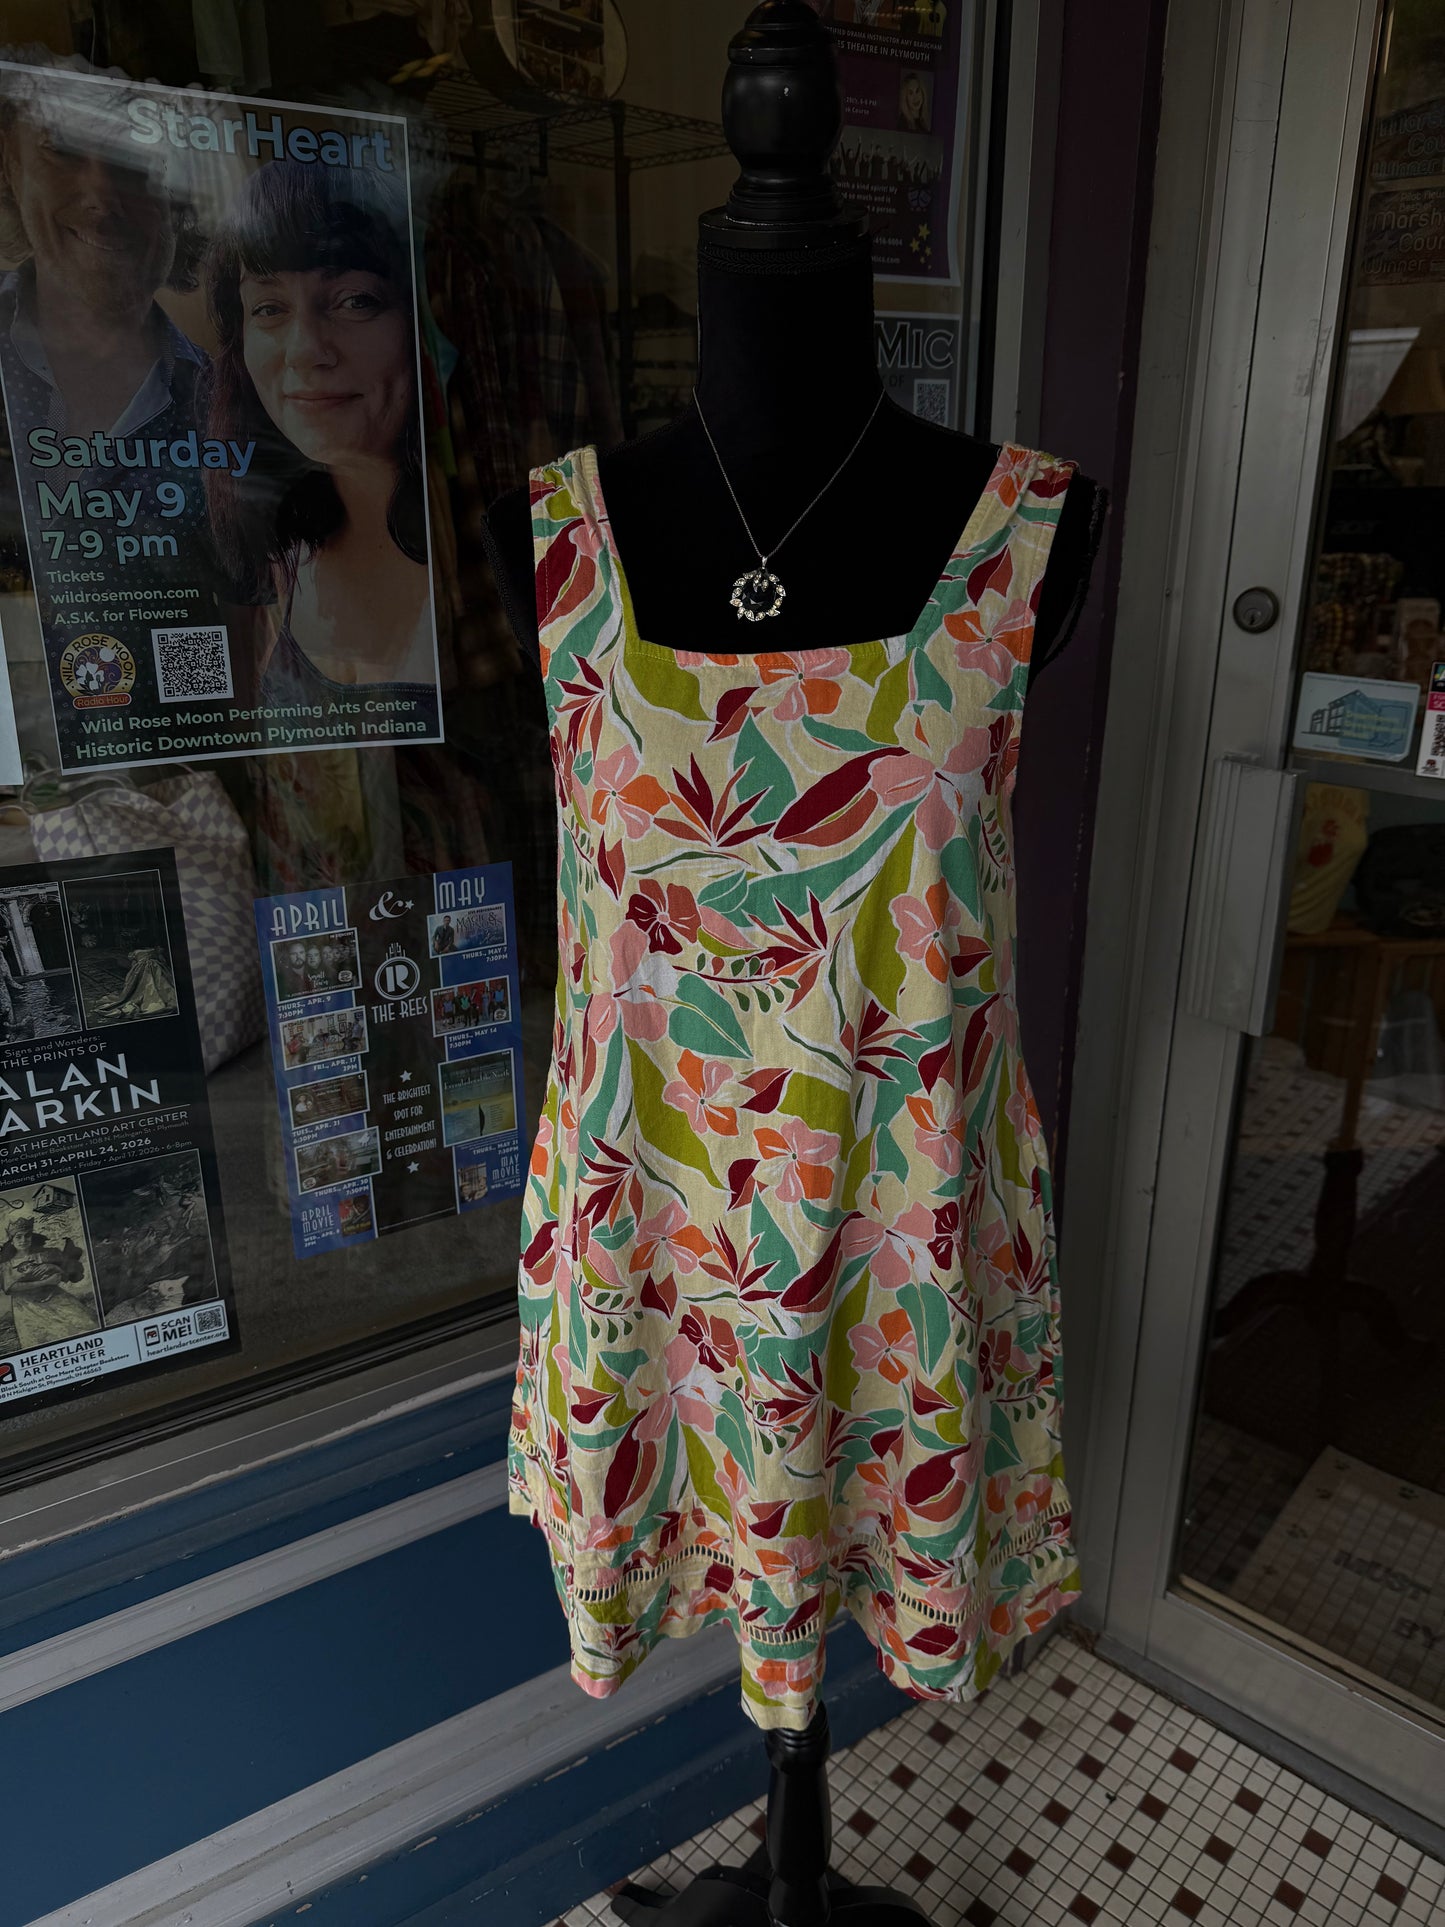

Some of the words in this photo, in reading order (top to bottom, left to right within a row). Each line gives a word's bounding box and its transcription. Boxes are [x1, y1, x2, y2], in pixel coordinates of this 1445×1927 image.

[846, 41, 878, 55] THEATRE
[880, 47, 888, 56] IN
[890, 48, 930, 61] PLYMOUTH
[127, 98, 395, 172] StarHeart
[1364, 258, 1426, 274] Winner
[874, 321, 954, 370] MIC
[27, 427, 257, 478] Saturday
[36, 481, 143, 528] May
[160, 481, 187, 519] 9
[41, 529, 104, 561] 7-9
[117, 530, 179, 565] pm
[47, 569, 105, 584] Tickets
[51, 586, 200, 605] wildrosemoon.com
[54, 611, 99, 626] A.S.K.
[103, 608, 126, 623] for
[128, 606, 189, 621] Flowers
[62, 652, 75, 685] WILD
[72, 635, 109, 652] ROSE
[111, 643, 134, 681] MOON
[77, 696, 104, 707] Radio
[106, 695, 129, 705] Hour
[82, 715, 124, 735] Wild
[129, 713, 172, 731] Rose
[176, 709, 225, 727] Moon
[229, 703, 323, 723] Performing
[327, 700, 361, 715] Arts
[364, 698, 418, 713] Center
[76, 739, 154, 760] Historic
[158, 729, 263, 751] Downtown
[267, 723, 357, 744] Plymouth
[361, 719, 428, 736] Indiana
[369, 891, 411, 921] &
[438, 876, 486, 910] MAY
[271, 899, 344, 937] APRIL
[488, 947, 502, 955] MAY
[278, 1009, 303, 1019] 7:30PM
[371, 1003, 395, 1025] THE
[398, 996, 428, 1018] REES
[4, 1047, 32, 1059] Signs
[34, 1043, 53, 1052] and
[54, 1035, 101, 1048] Wonders:
[474, 1029, 488, 1037] MAY
[0, 1057, 30, 1071] THE
[33, 1045, 85, 1064] PRINTS
[88, 1041, 108, 1053] OF
[0, 1053, 129, 1101] ALAN
[0, 1079, 161, 1138] ARKIN
[383, 1092, 396, 1105] THE
[397, 1084, 431, 1102] BRIGHTEST
[393, 1108, 409, 1121] SPOT
[411, 1105, 424, 1118] FOR
[13, 1143, 28, 1155] AT
[31, 1127, 110, 1150] HEARTLAND
[112, 1121, 136, 1133] ART
[138, 1111, 189, 1127] CENTER
[384, 1120, 435, 1142] ENTERTAINMENT
[0, 1161, 38, 1178] ARCH
[40, 1149, 98, 1168] 31-APRIL
[121, 1138, 152, 1150] 2026
[0, 1174, 36, 1187] Honoring
[36, 1171, 49, 1179] the
[50, 1166, 73, 1176] Artist
[79, 1159, 103, 1169] Friday
[108, 1153, 126, 1163] April
[139, 1146, 160, 1156] 2026
[492, 1164, 520, 1180] MOVIE
[501, 1153, 519, 1168] MAY
[302, 1204, 332, 1223] APRIL
[303, 1215, 335, 1234] MOVIE
[161, 1315, 190, 1330] SCAN
[163, 1324, 192, 1342] ME!
[20, 1337, 103, 1367] HEARTLAND
[147, 1331, 228, 1357] heartlandartcenter.org
[1, 1384, 18, 1393] Block
[19, 1379, 38, 1388] South
[45, 1373, 58, 1381] One
[59, 1369, 74, 1378] More
[75, 1362, 99, 1373] Chapter
[24, 1364, 49, 1378] ART
[54, 1349, 106, 1369] CENTER
